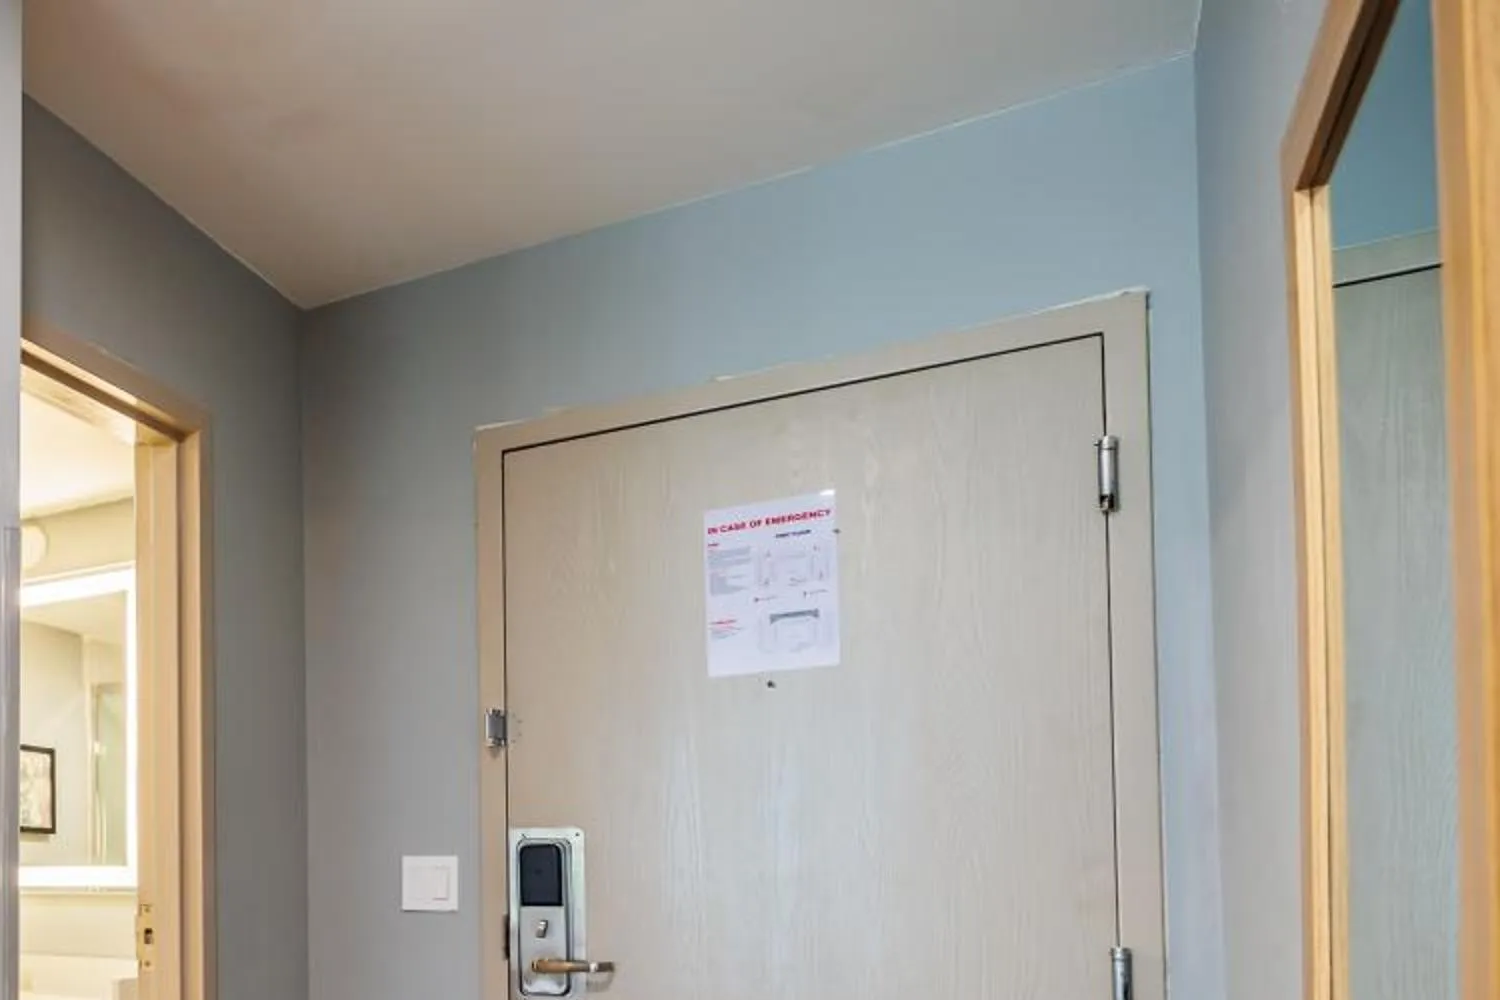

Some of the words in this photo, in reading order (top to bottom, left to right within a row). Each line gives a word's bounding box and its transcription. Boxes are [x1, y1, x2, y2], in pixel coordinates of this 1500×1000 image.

[708, 527, 718, 535] IN
[720, 523, 746, 533] CASE
[750, 519, 762, 529] OF
[765, 509, 831, 526] EMERGENCY
